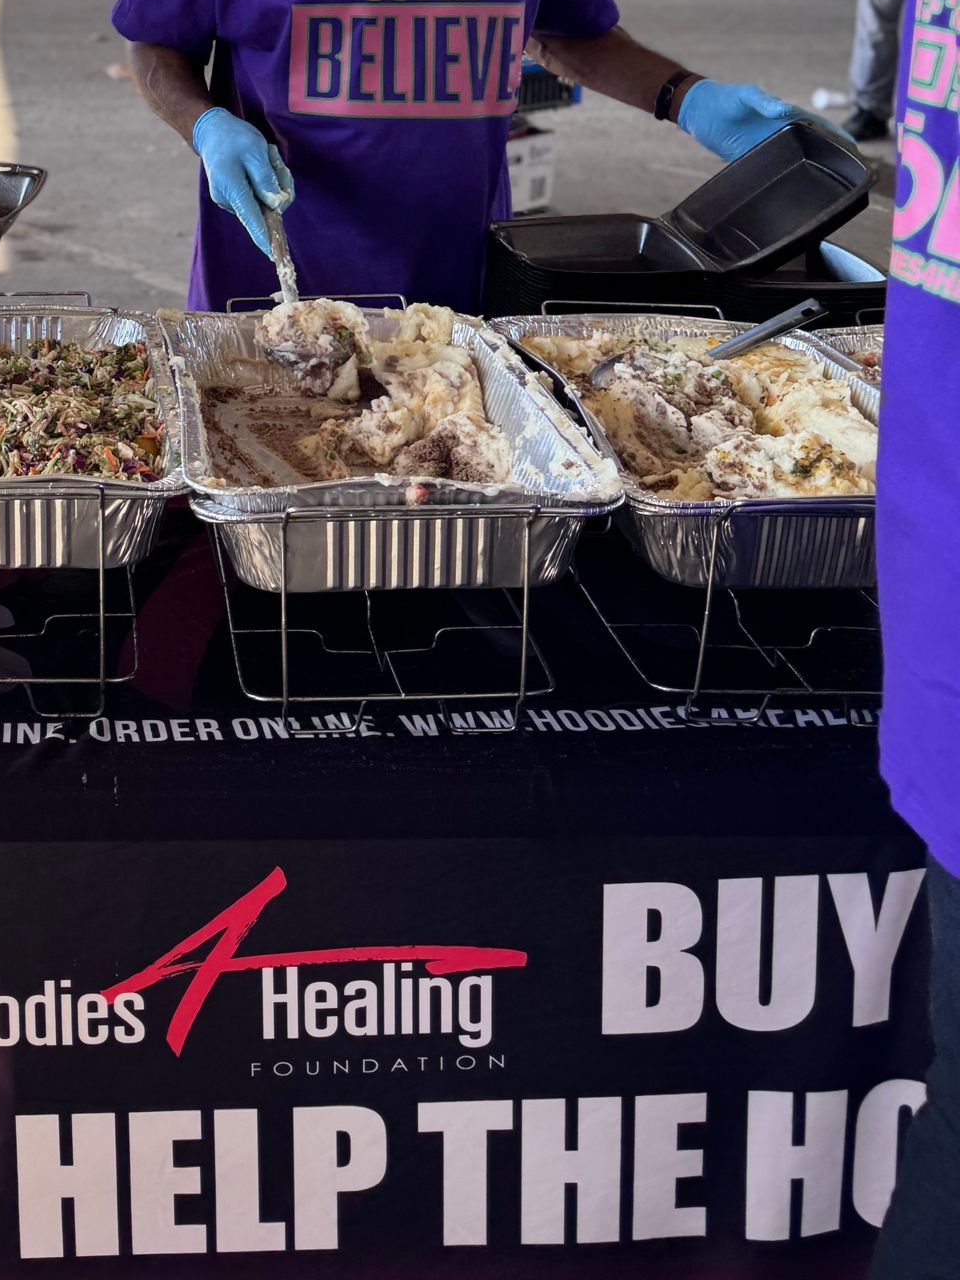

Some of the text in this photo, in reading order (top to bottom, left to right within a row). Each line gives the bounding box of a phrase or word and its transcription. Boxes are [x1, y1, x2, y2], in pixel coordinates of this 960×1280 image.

[305, 16, 521, 104] BELIEVE
[89, 717, 224, 743] ORDER
[601, 867, 927, 1036] BUY
[261, 962, 493, 1048] Healing
[250, 1053, 507, 1077] FOUNDATION
[15, 1104, 389, 1260] HELP
[417, 1092, 708, 1248] THE
